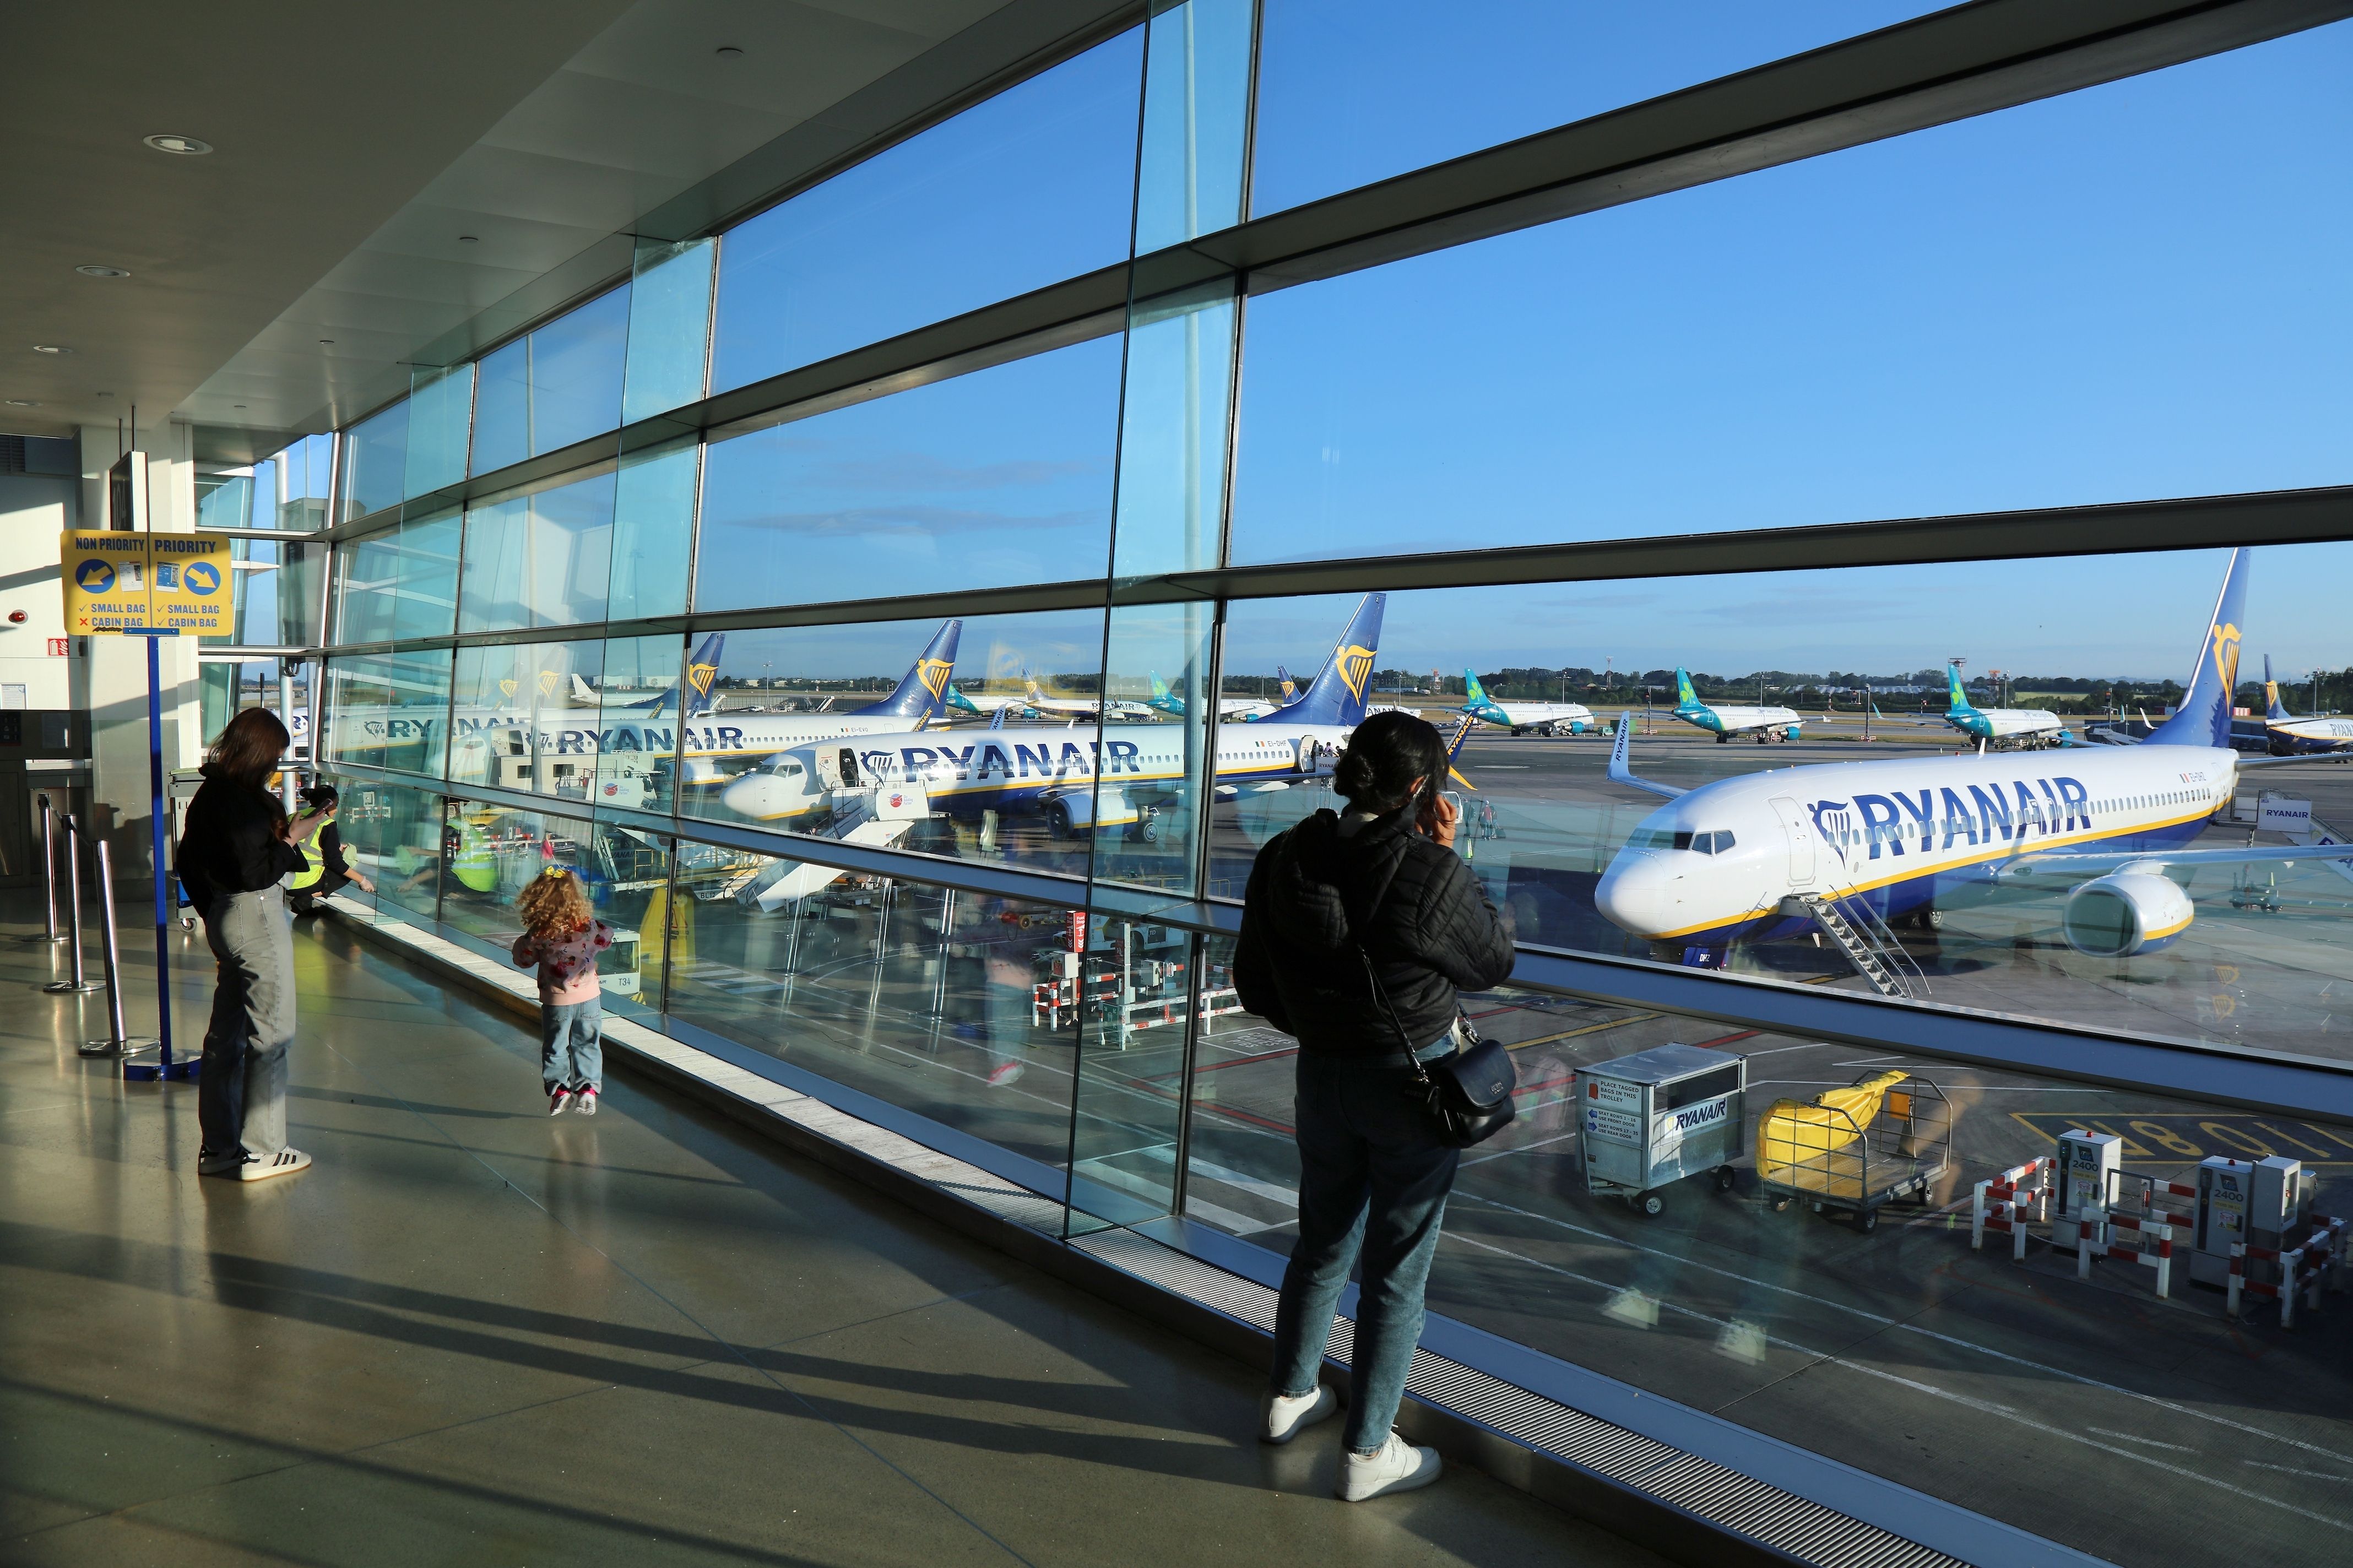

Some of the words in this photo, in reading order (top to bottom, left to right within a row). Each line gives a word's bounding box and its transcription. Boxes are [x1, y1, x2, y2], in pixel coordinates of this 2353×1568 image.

[75, 537, 97, 550] NON
[99, 538, 144, 551] PRIORITY
[155, 539, 216, 553] PRIORITY
[91, 603, 123, 612] SMALL
[126, 604, 145, 613] BAG
[167, 604, 199, 614] SMALL
[201, 605, 219, 614] BAG
[91, 617, 121, 627] CABIN
[124, 617, 143, 627] BAG
[168, 618, 196, 627] CABIN
[198, 618, 217, 627] BAG
[1447, 715, 1474, 756] RYANAIR
[1615, 719, 1628, 761] RYANAIR
[1851, 777, 2091, 860] RYANAIR
[2266, 810, 2308, 818] RYANAIR
[1699, 953, 1710, 962] DHZ
[619, 978, 631, 986] T34
[1238, 1035, 1279, 1046] CONES
[1247, 1032, 1296, 1044] CHOCKS
[1226, 1039, 1259, 1048] PIGS
[1618, 1084, 1639, 1093] TAGGED
[1601, 1094, 1623, 1102] TROLLEY
[1675, 1099, 1726, 1131] RYANAIR
[2073, 1160, 2099, 1171] 2400
[2214, 1189, 2244, 1202] 2400
